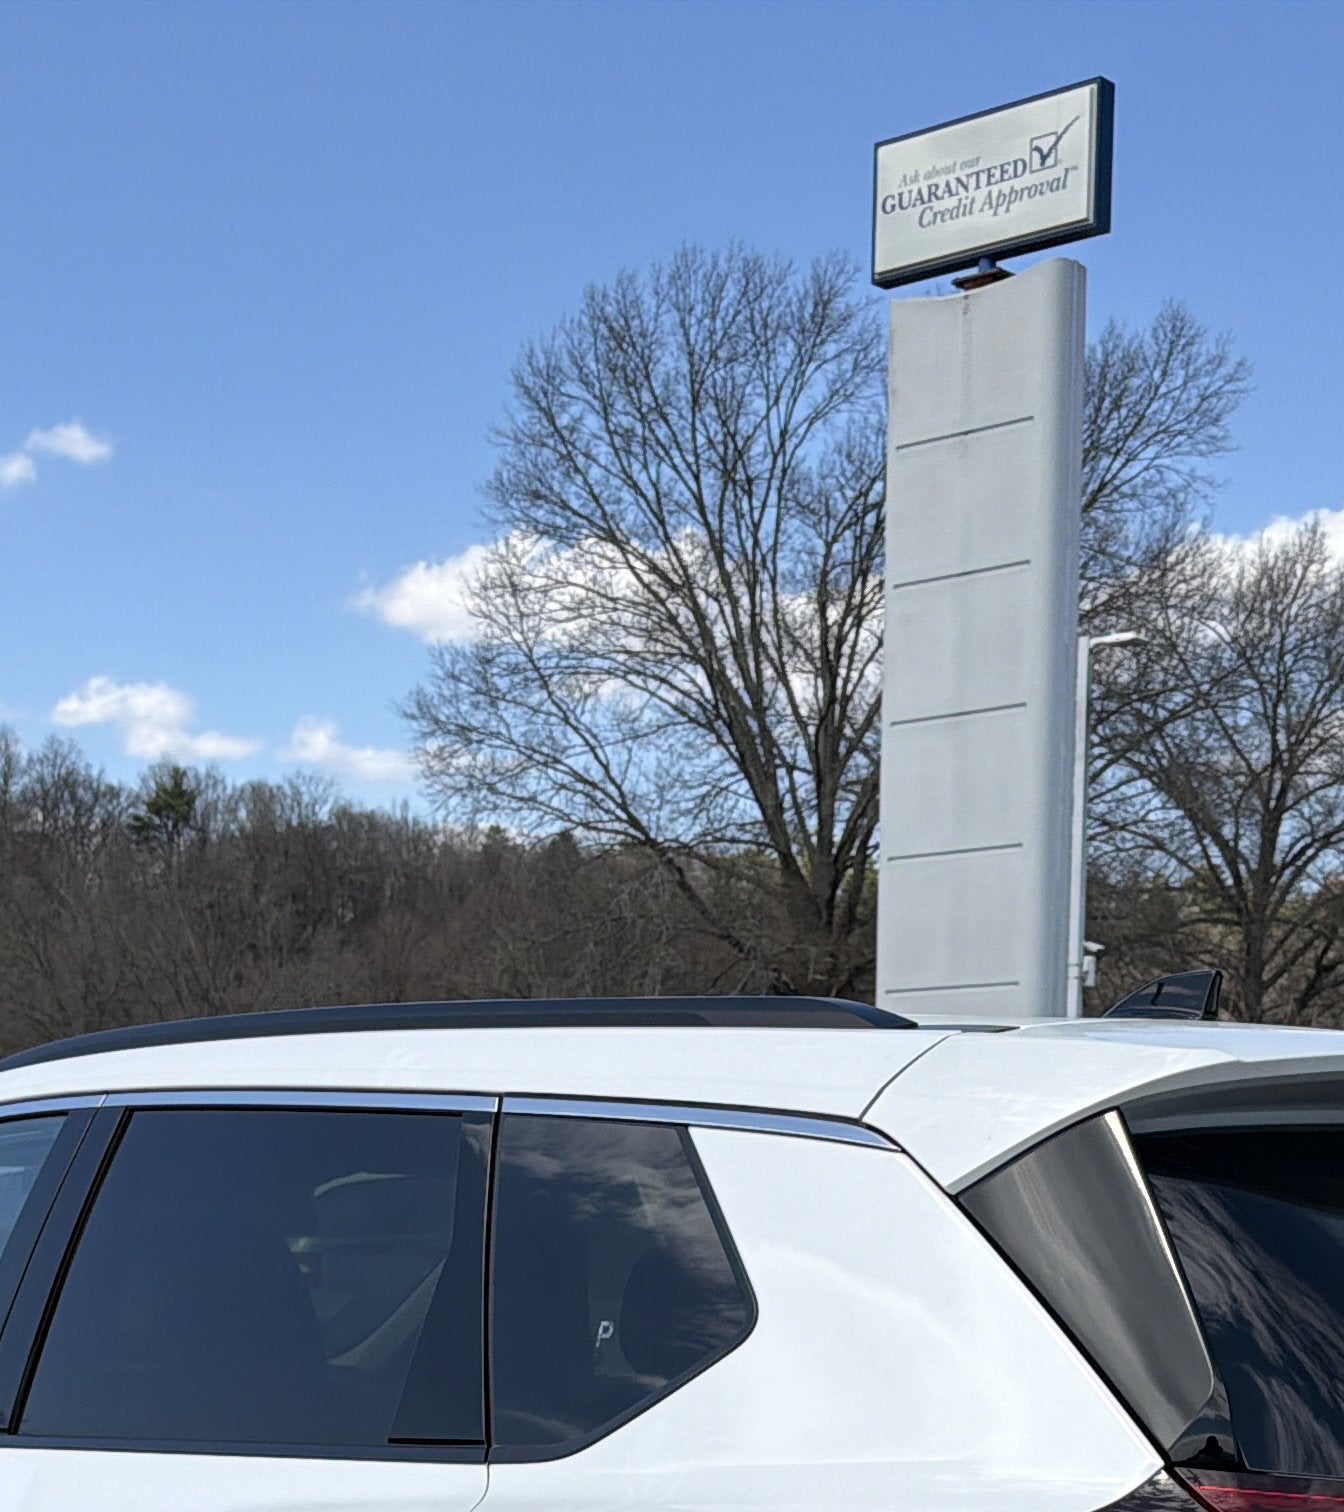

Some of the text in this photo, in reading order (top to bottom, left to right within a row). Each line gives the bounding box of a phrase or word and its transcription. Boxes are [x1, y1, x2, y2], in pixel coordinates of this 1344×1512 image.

[881, 158, 1027, 215] GUARANTEED
[898, 156, 981, 189] Ask about our
[918, 166, 1070, 228] Credit Approval
